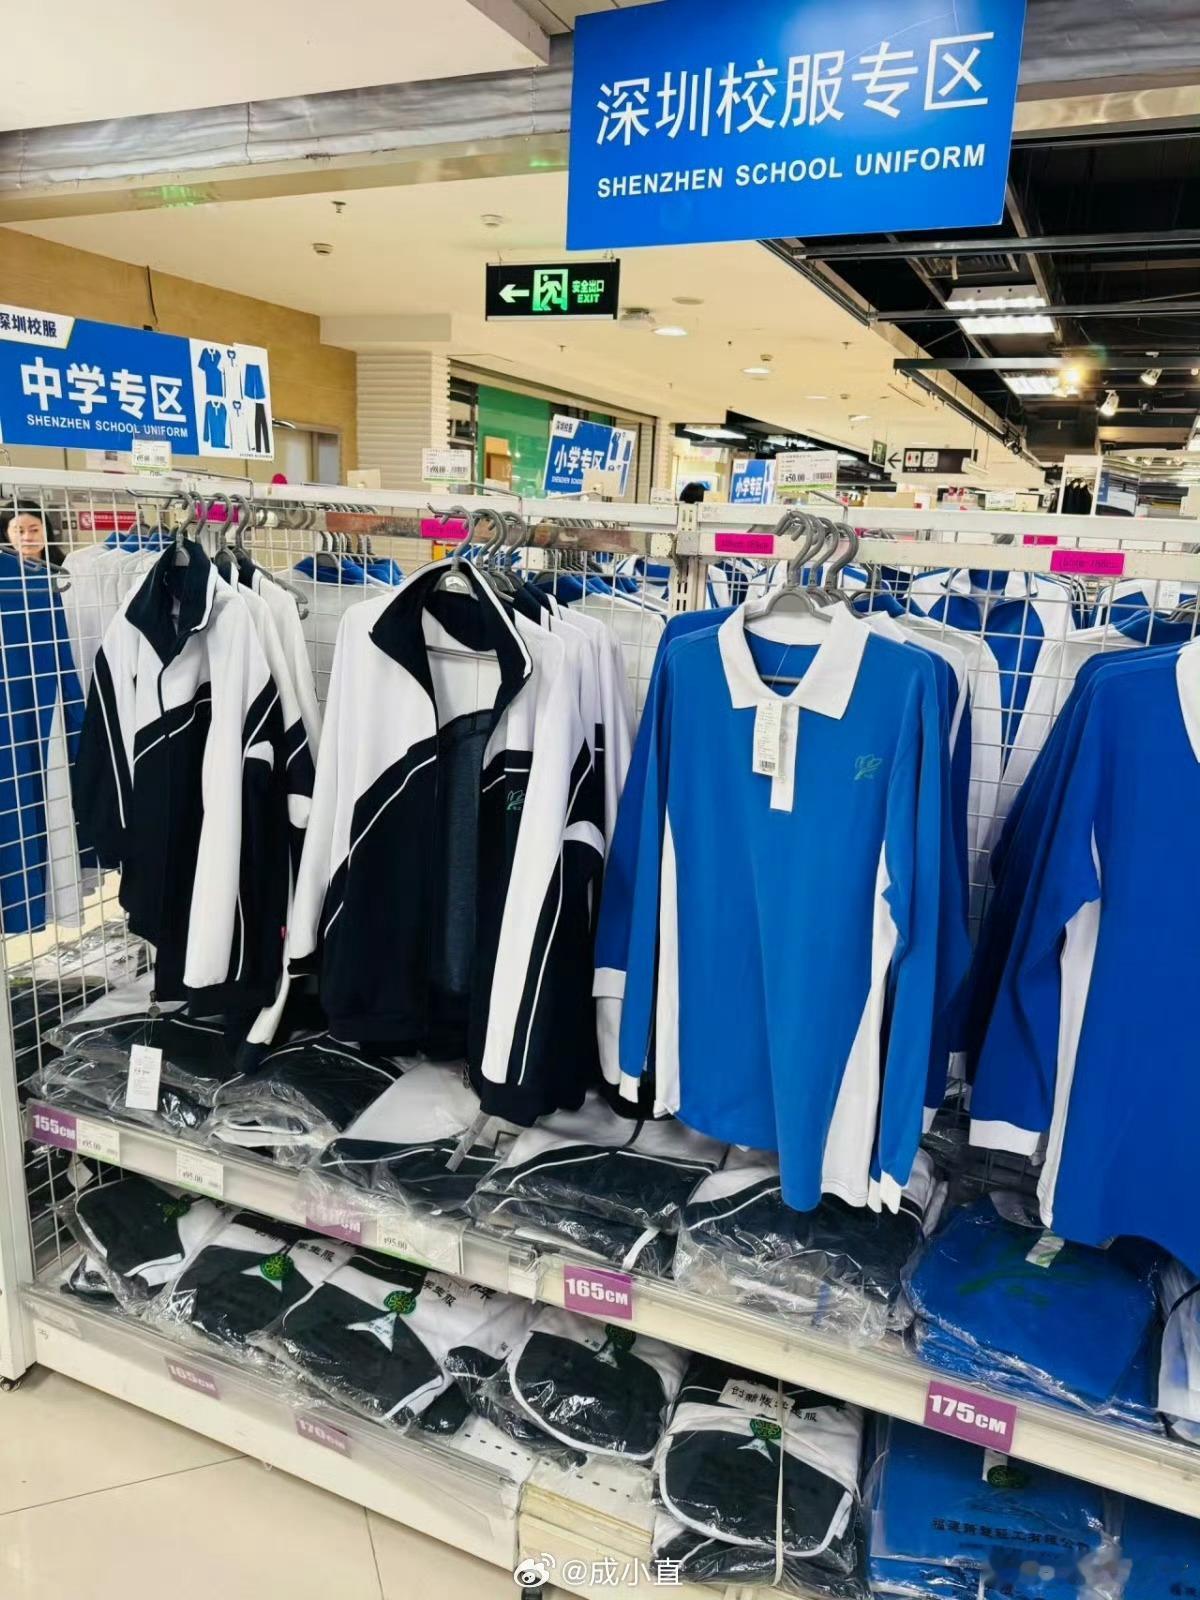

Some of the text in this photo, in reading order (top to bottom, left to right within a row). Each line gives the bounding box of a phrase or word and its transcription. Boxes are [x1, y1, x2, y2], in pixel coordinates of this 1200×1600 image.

[595, 31, 995, 147] 深圳校服专区
[597, 143, 985, 198] SHENZHEN SCHOOL UNIFORM
[572, 280, 604, 294] 安全出口
[577, 294, 600, 304] EXIT
[0, 313, 58, 339] 深圳校服
[20, 356, 187, 423] 中学专区
[27, 414, 189, 438] SHENZHEN SCHOOL UNIFORM
